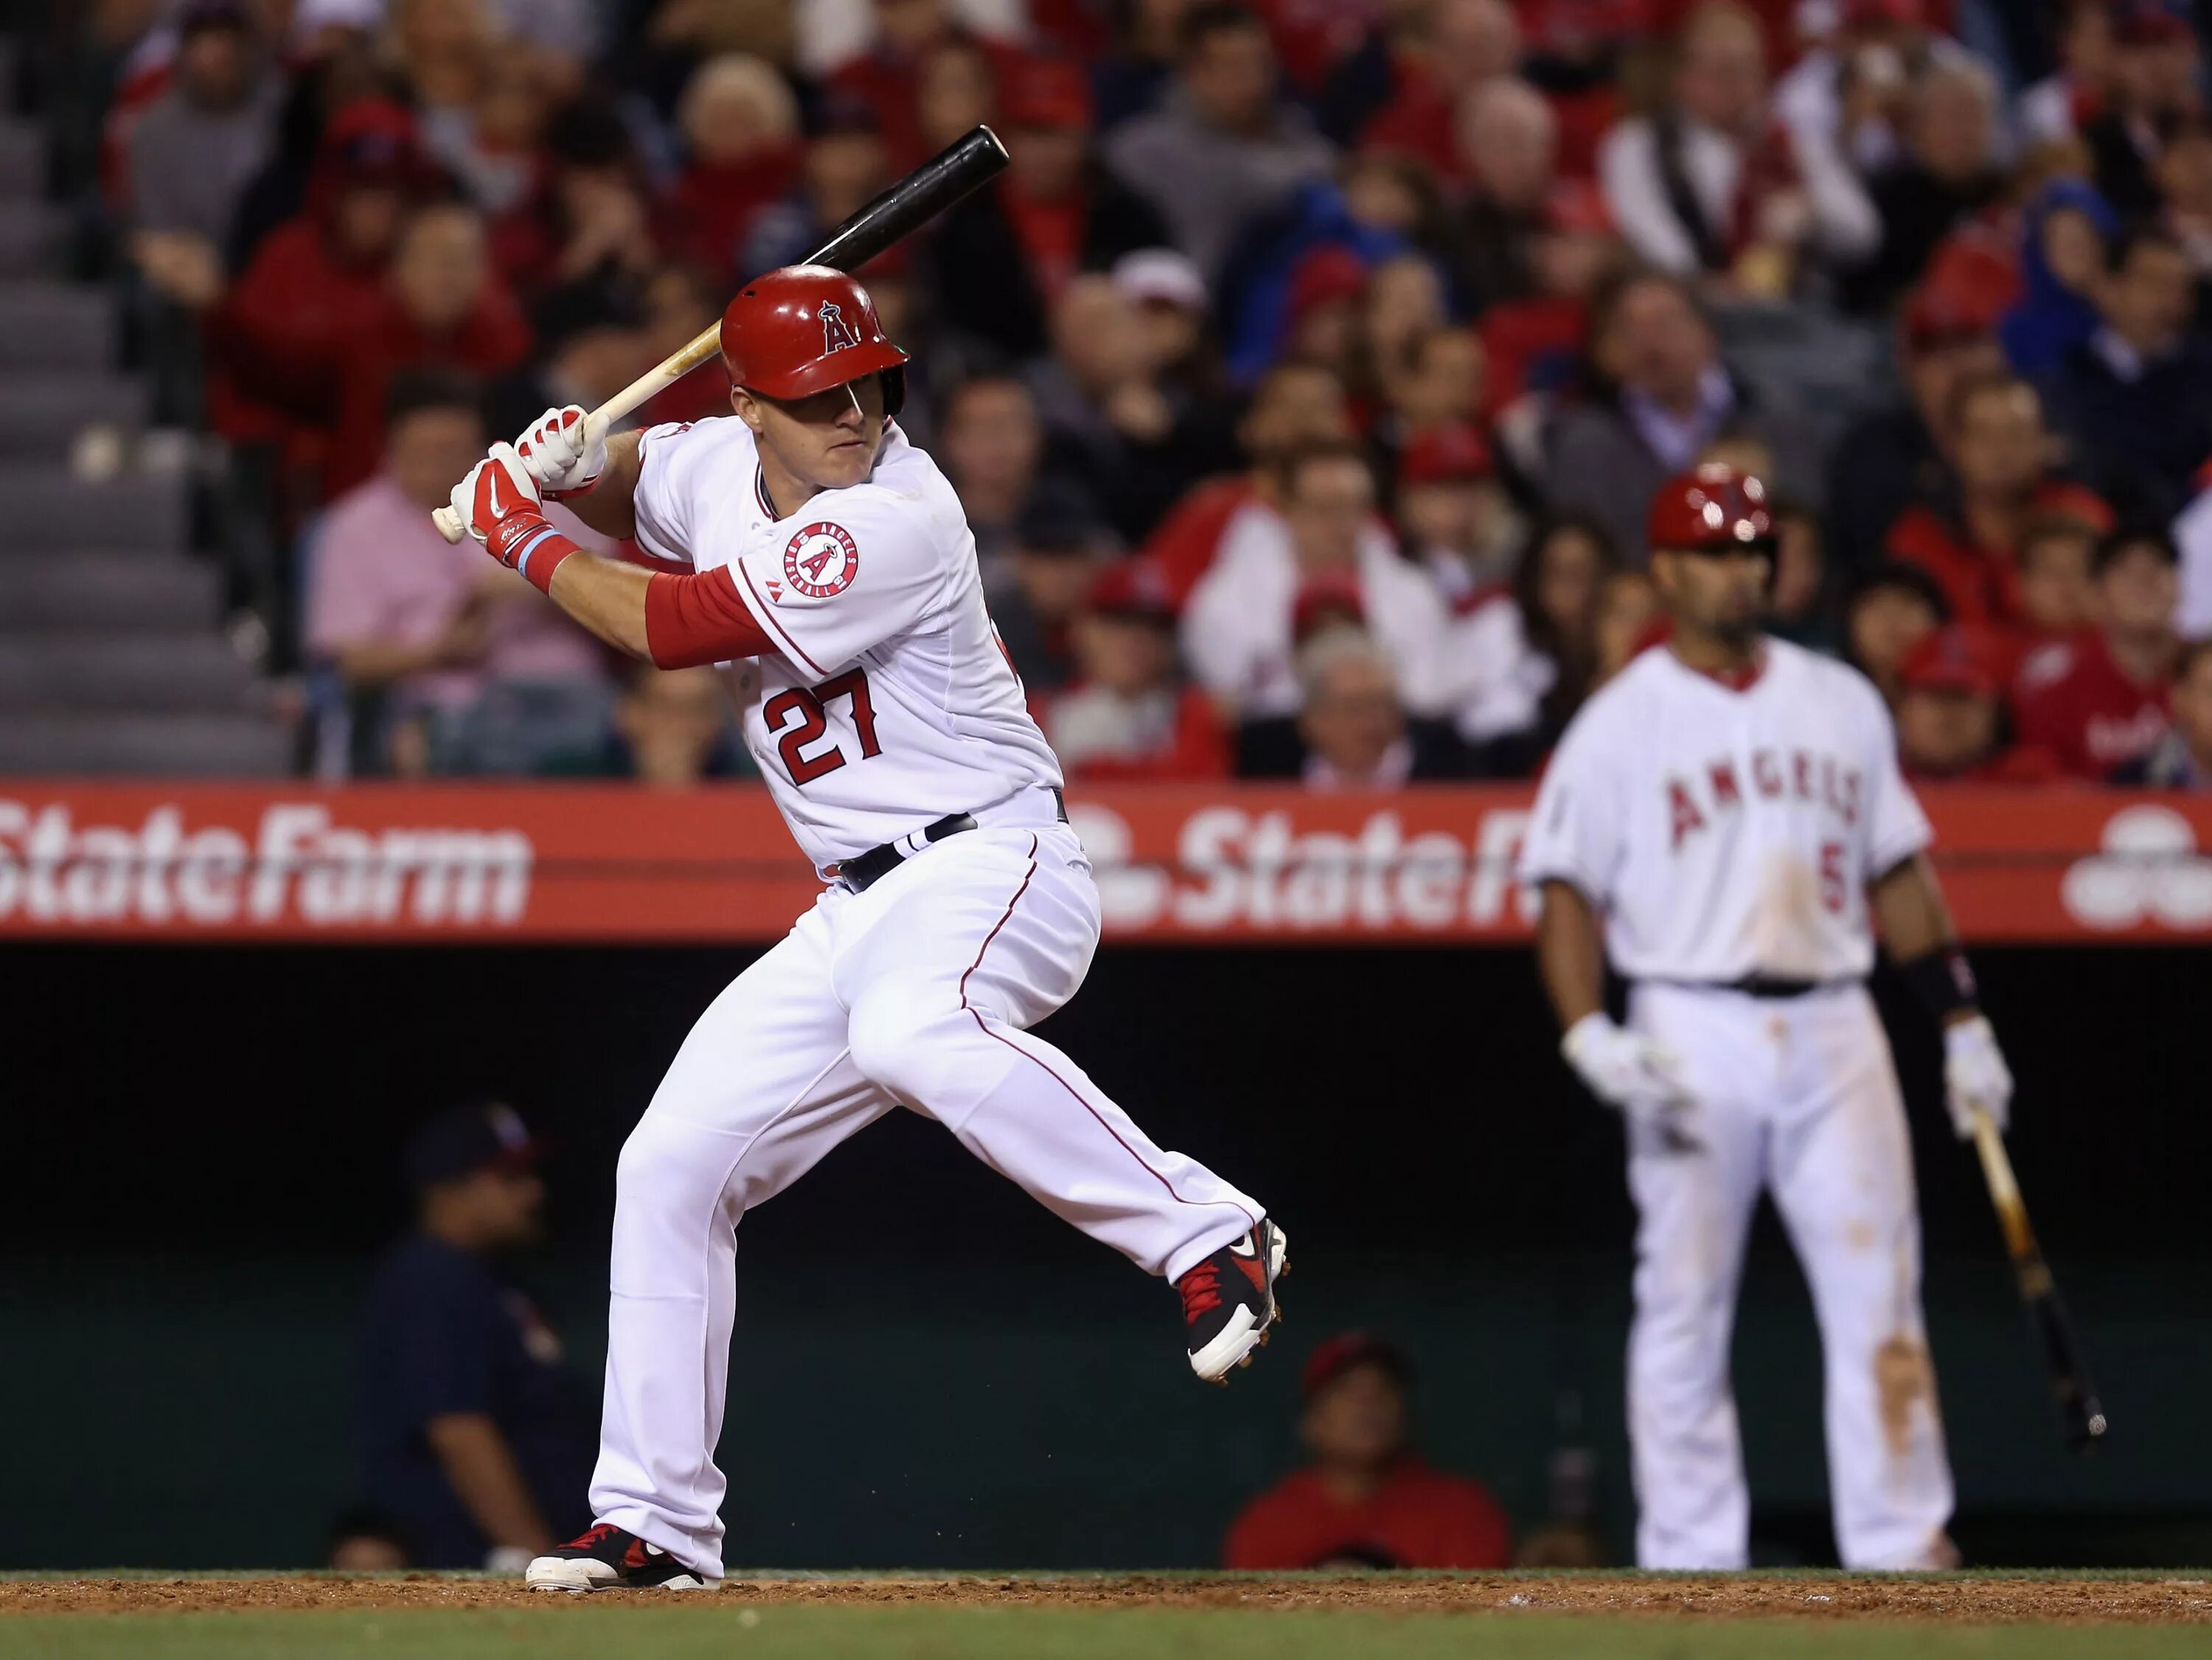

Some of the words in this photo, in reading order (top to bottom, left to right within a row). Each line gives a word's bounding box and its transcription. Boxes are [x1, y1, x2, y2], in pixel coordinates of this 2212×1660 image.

[818, 299, 858, 355] A
[796, 531, 810, 546] 19
[821, 523, 857, 564] ANGELS
[784, 545, 831, 597] BASEBALL
[832, 574, 848, 591] 61
[762, 665, 883, 787] 27
[1664, 748, 1862, 852] ANGELS
[1818, 841, 1846, 916] 5
